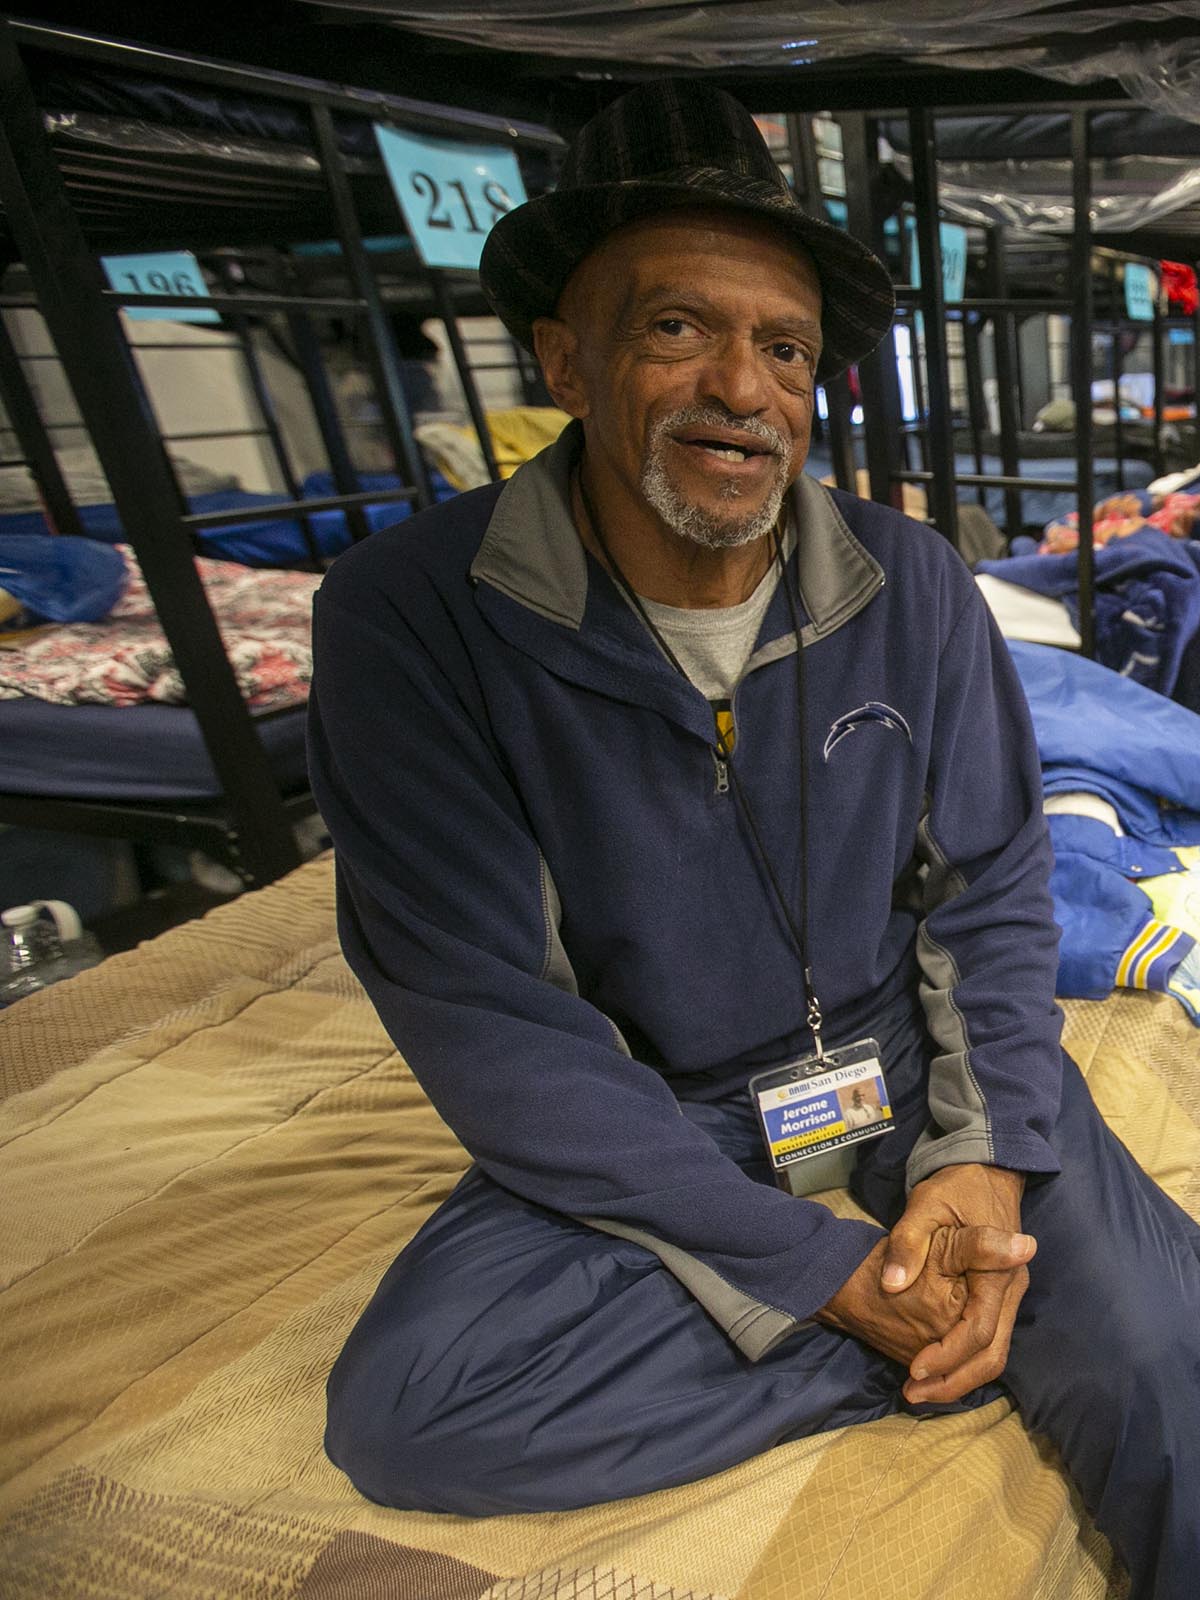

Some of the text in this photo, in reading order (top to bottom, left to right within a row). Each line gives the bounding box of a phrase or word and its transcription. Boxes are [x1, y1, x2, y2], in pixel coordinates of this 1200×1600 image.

[811, 1077, 832, 1088] San
[834, 1066, 867, 1081] Diego
[783, 1099, 828, 1121] Jerome
[781, 1110, 837, 1135] Morrison
[779, 1141, 833, 1162] CONNECTION
[840, 1121, 889, 1142] COMMUNITY
